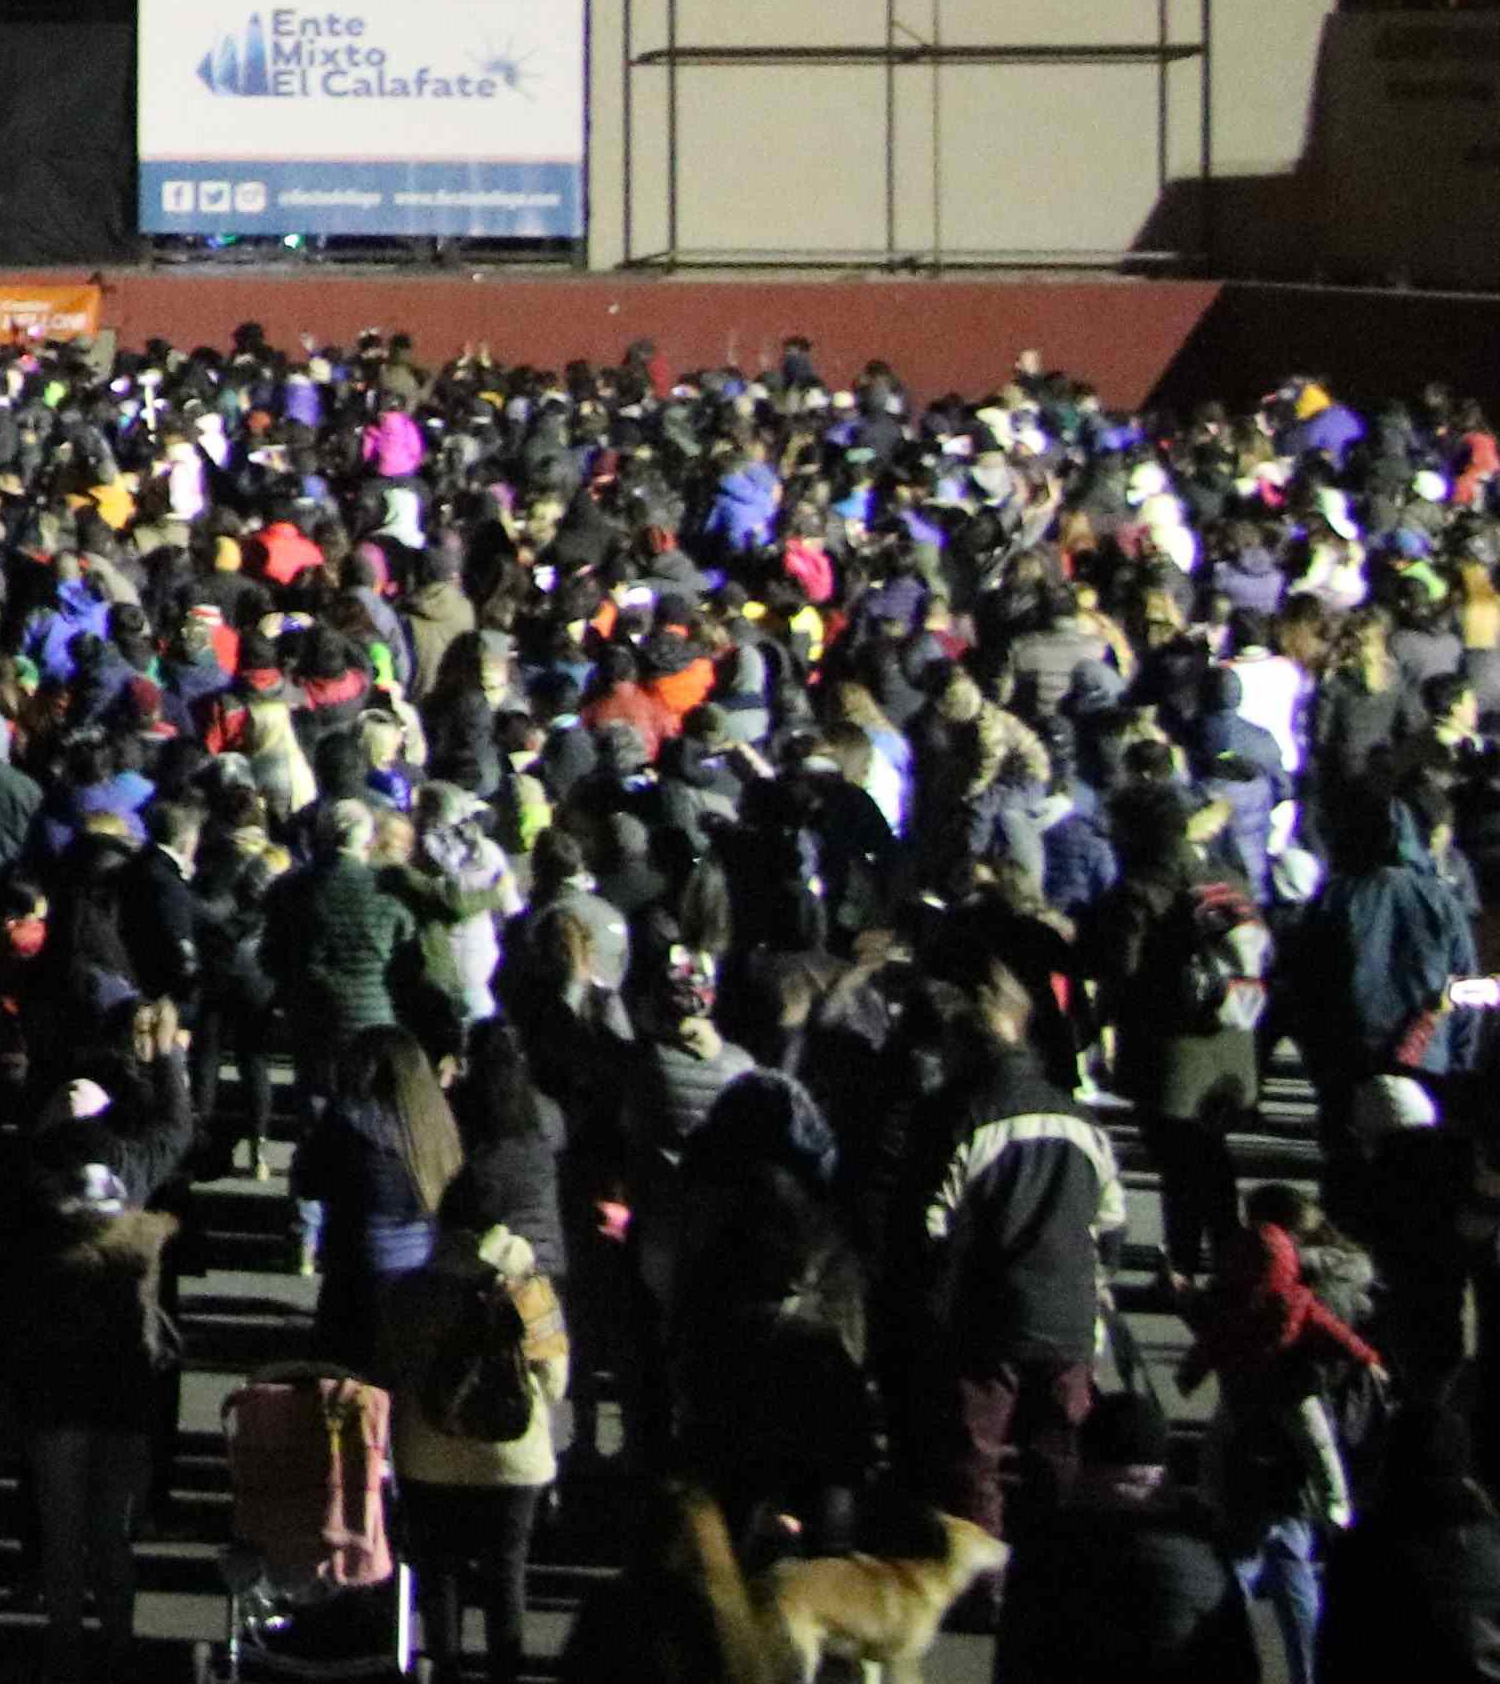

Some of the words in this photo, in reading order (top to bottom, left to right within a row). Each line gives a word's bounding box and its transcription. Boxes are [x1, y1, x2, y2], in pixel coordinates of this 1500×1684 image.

[271, 8, 366, 38] Ente
[271, 38, 388, 68] Mixto
[272, 69, 309, 98] El
[321, 67, 498, 99] Calafate
